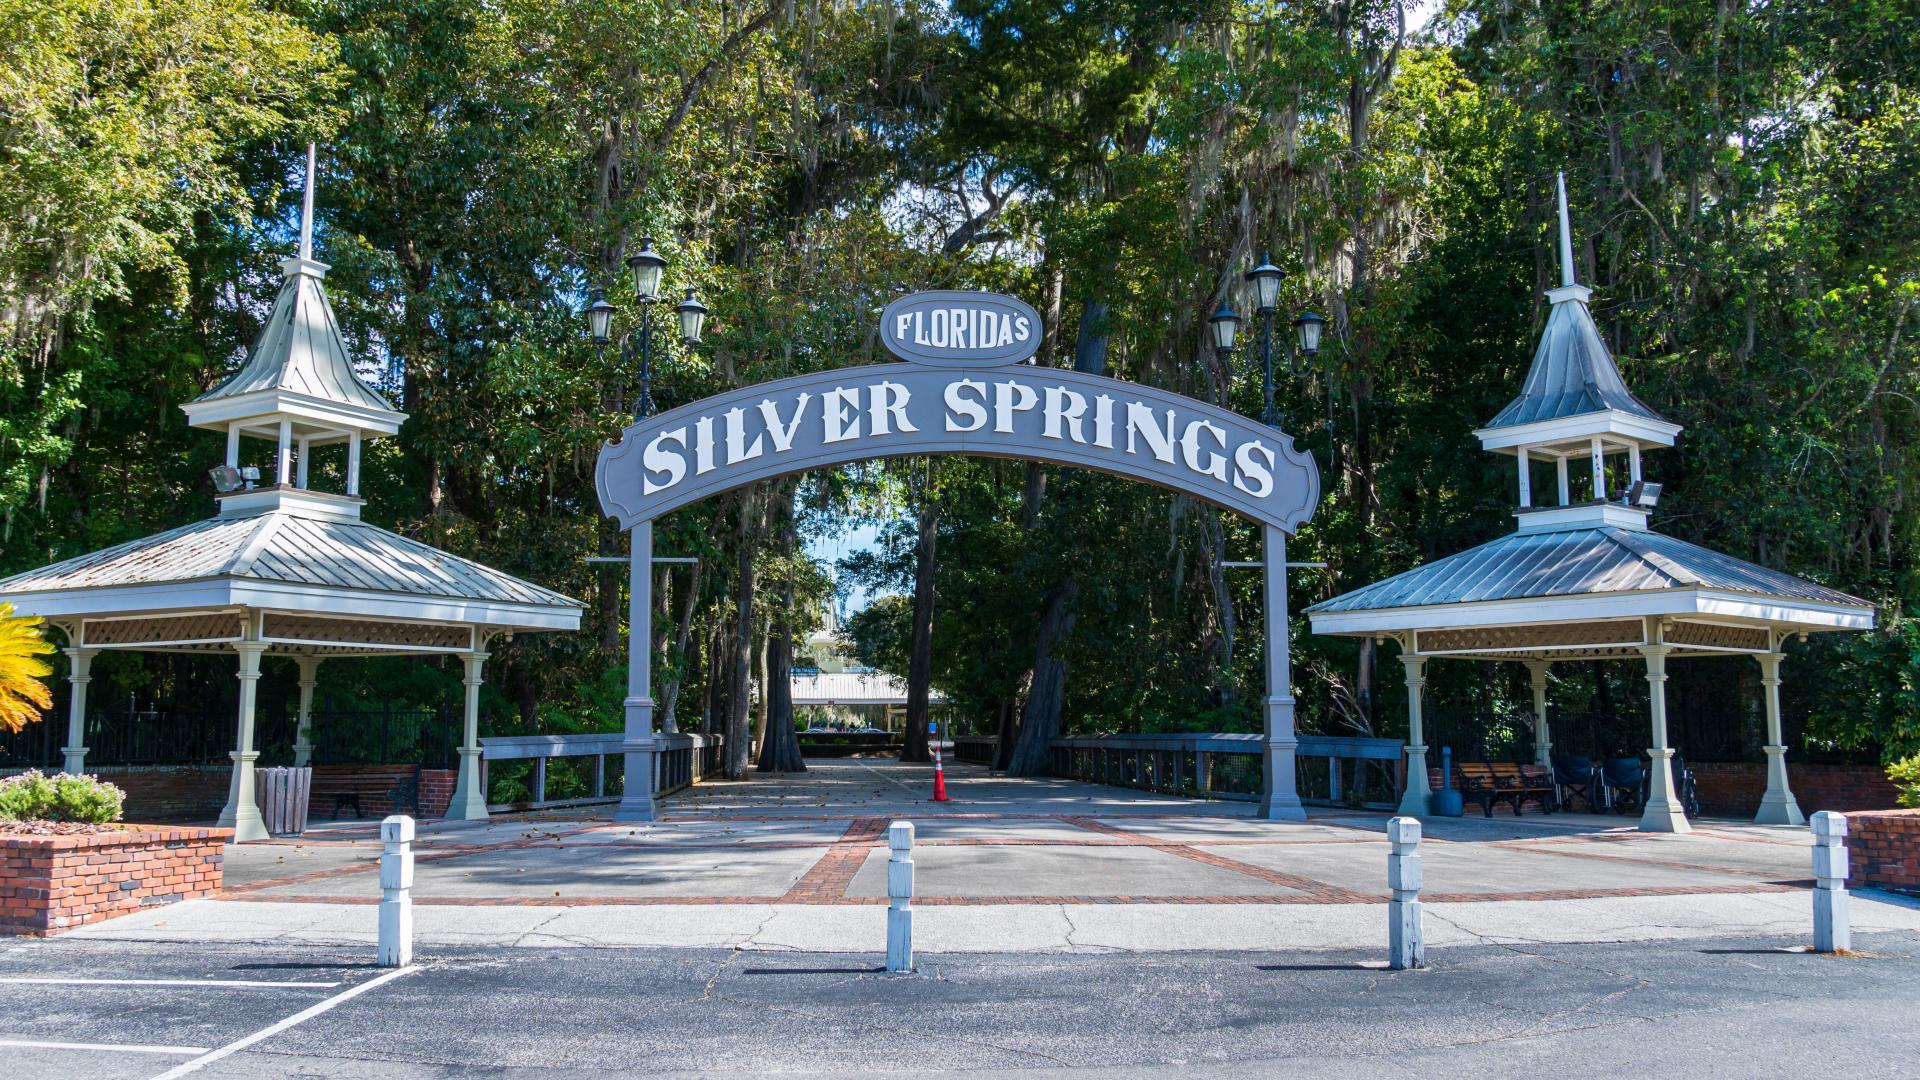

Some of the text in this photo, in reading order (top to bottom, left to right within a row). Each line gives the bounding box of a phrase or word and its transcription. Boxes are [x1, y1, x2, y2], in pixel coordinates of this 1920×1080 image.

[896, 308, 1030, 349] FLORIDA'S
[642, 378, 1276, 498] SILVER SPRINGS
